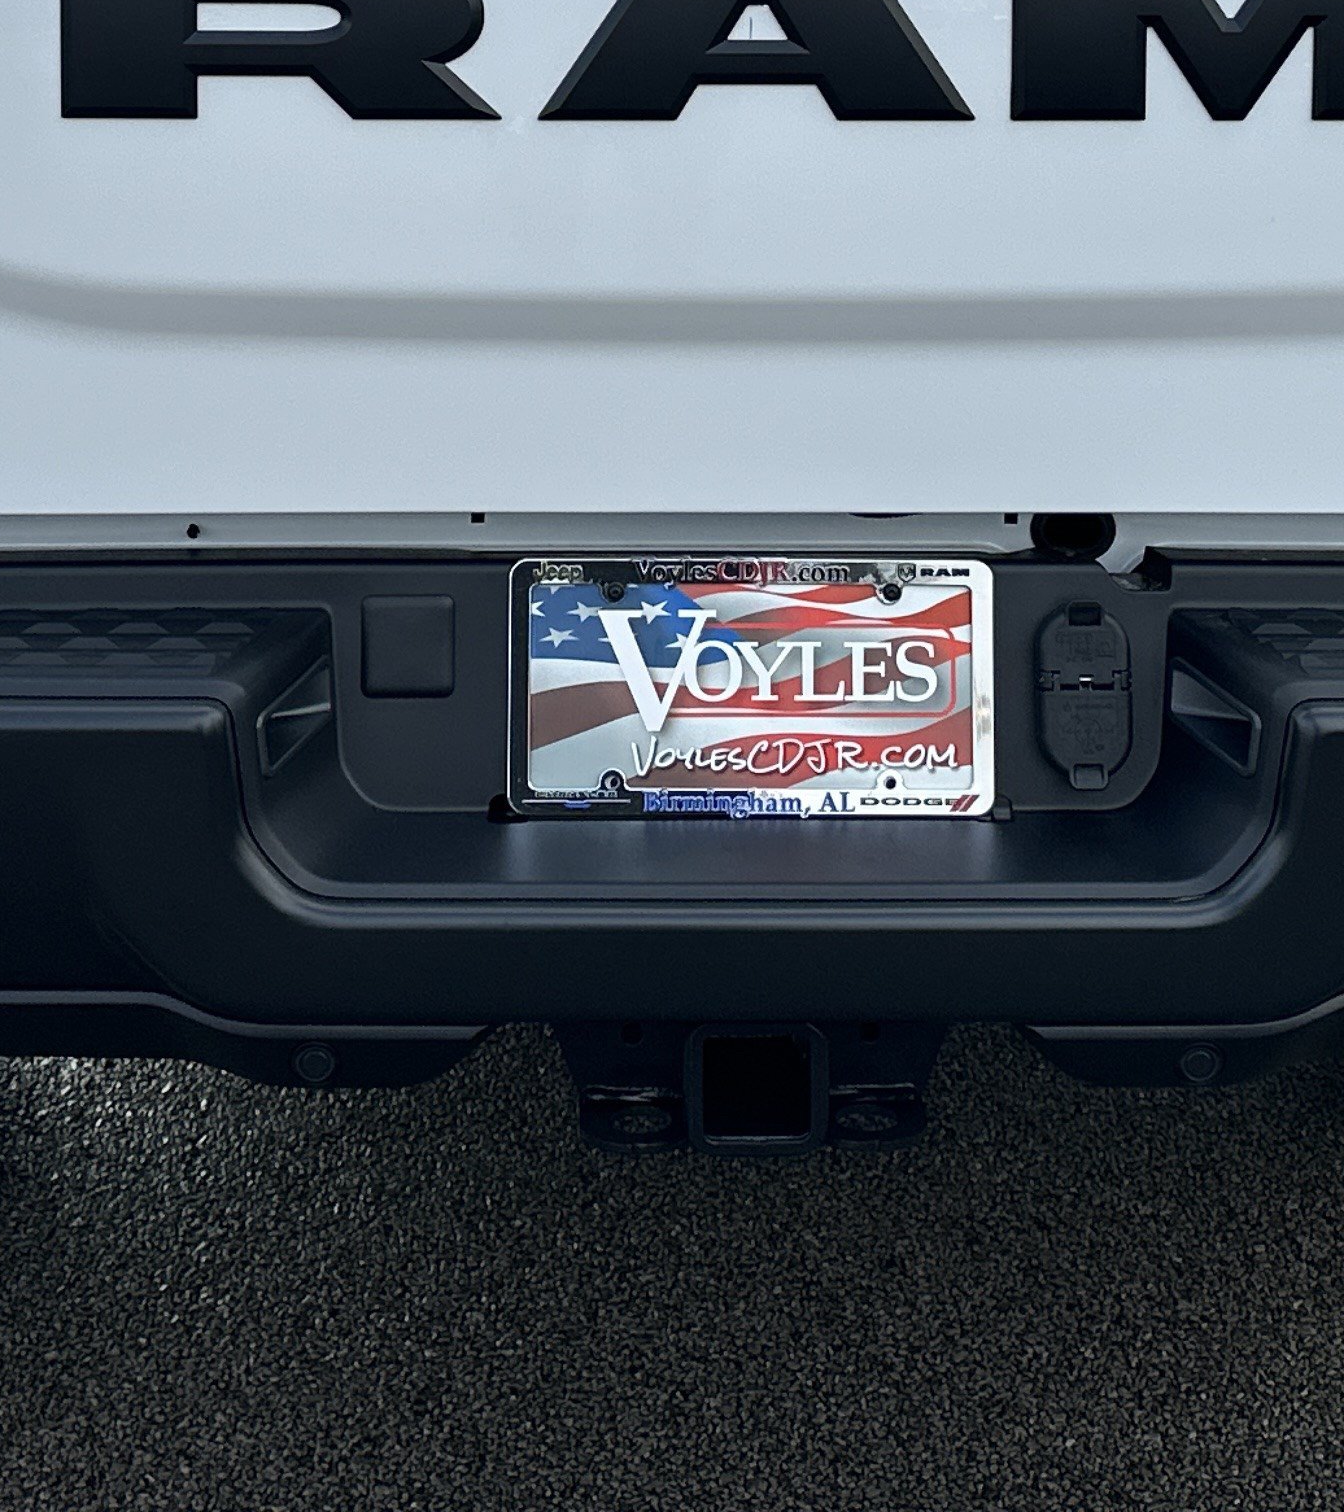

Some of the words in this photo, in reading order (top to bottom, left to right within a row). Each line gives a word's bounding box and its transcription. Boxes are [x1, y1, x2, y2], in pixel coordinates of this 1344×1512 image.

[532, 559, 585, 583] Jeep
[919, 567, 970, 577] RAM
[642, 787, 811, 819] Birmingham,
[817, 791, 856, 813] AL
[859, 796, 959, 807] DODGE
